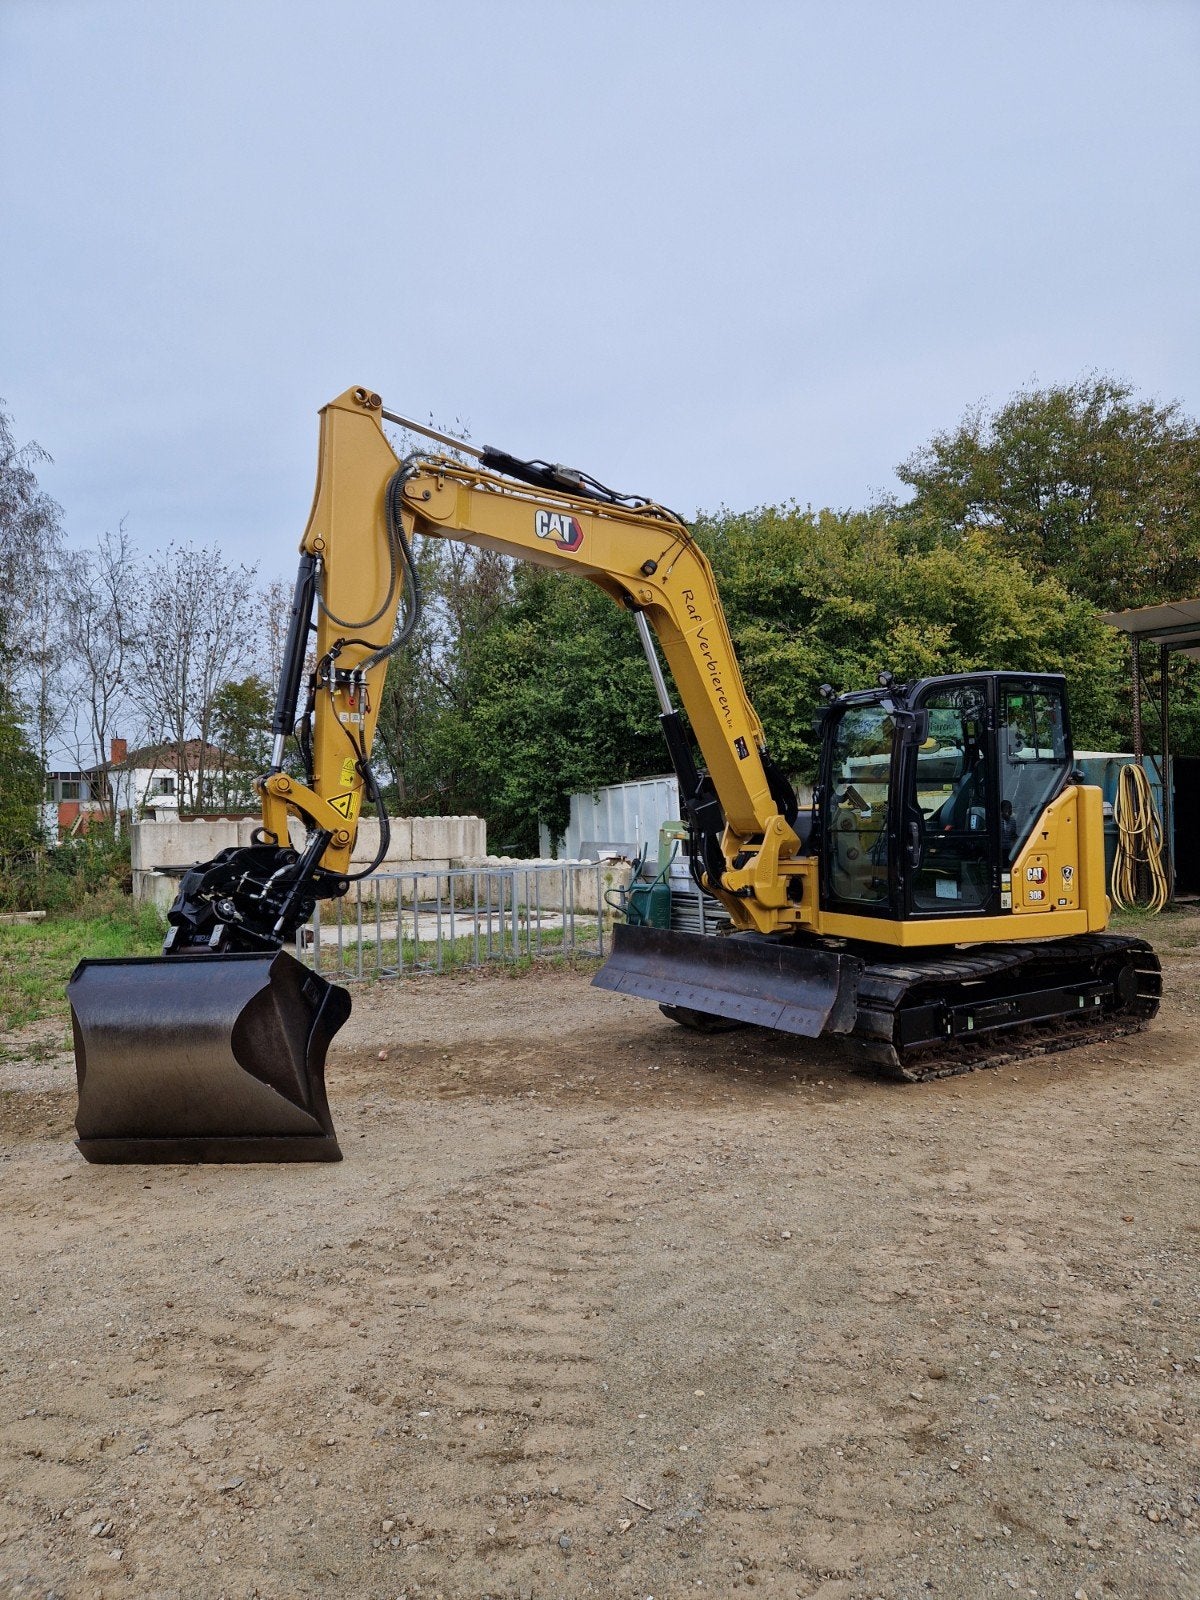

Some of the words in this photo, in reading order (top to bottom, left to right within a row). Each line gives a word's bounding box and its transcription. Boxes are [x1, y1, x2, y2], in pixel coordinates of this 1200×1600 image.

[535, 509, 573, 543] CAT
[682, 589, 702, 622] Raf
[1027, 867, 1043, 881] CAT
